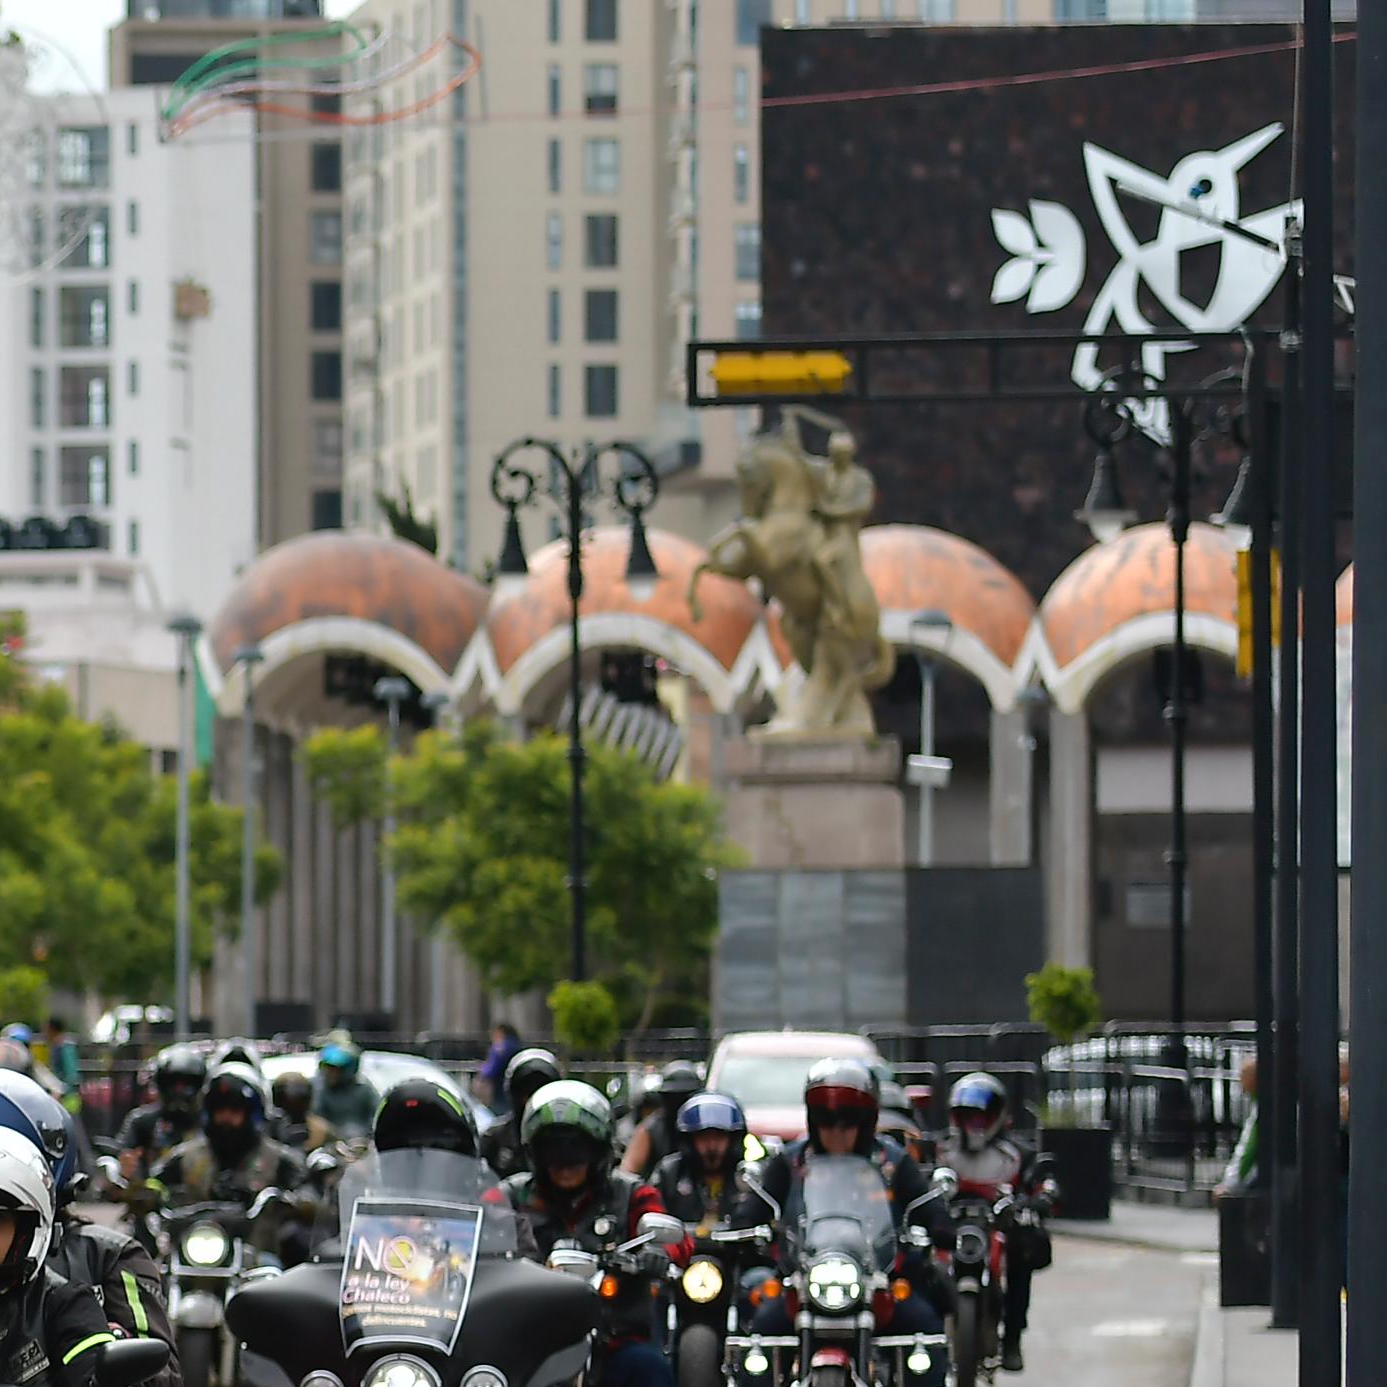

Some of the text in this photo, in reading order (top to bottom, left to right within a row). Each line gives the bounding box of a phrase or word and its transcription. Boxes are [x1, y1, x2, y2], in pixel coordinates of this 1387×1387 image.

[365, 1272, 379, 1287] la
[385, 1274, 410, 1293] ley
[342, 1288, 411, 1304] Chaleco
